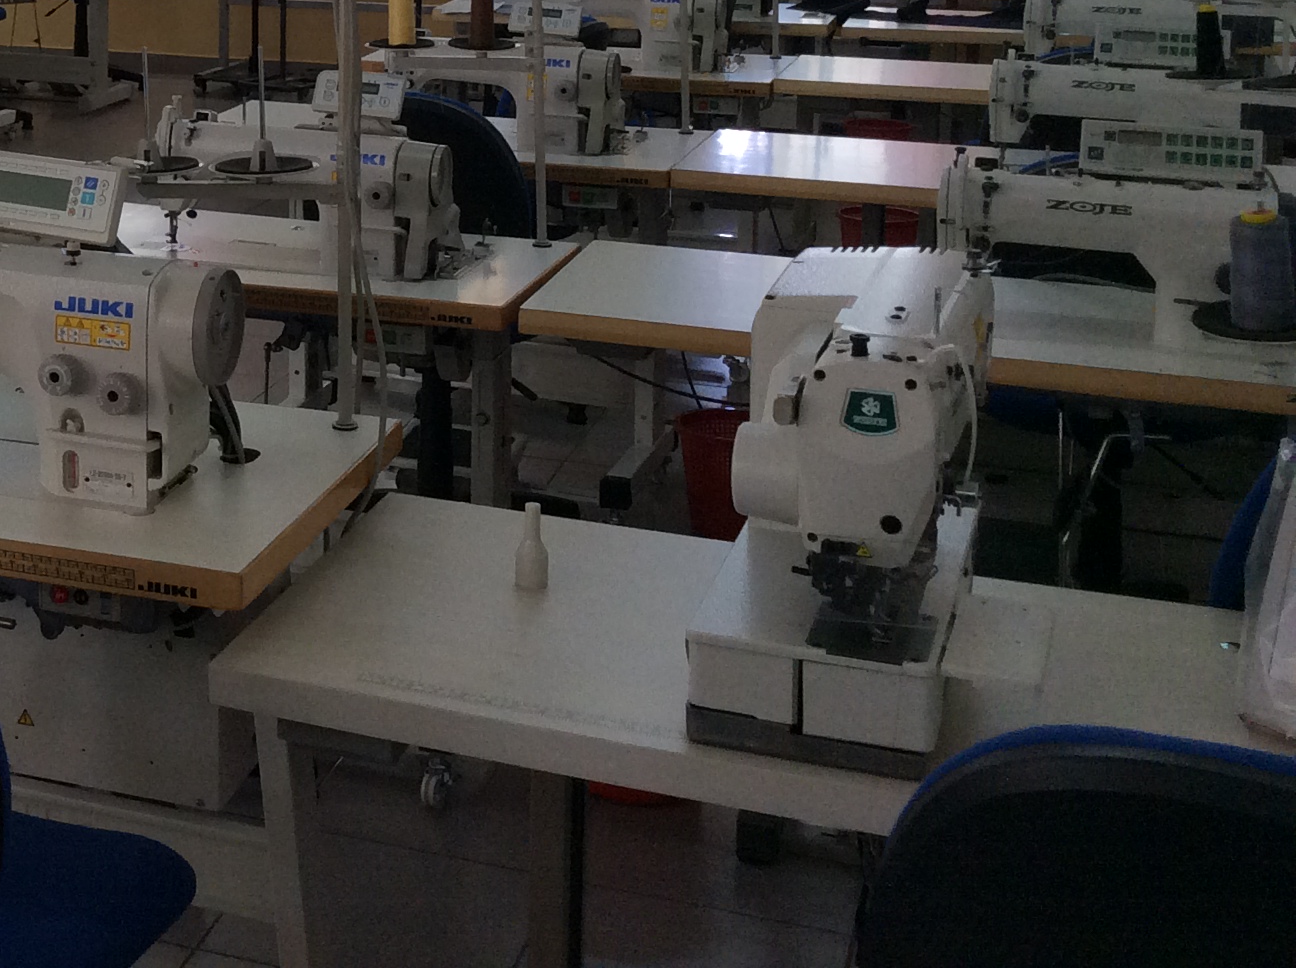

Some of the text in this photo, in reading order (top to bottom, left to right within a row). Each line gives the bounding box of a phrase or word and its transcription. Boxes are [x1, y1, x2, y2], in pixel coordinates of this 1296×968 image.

[1071, 79, 1136, 93] ZOJE
[1045, 198, 1133, 216] ZOJE
[54, 296, 134, 319] JUKI
[137, 581, 197, 599] JUKI
